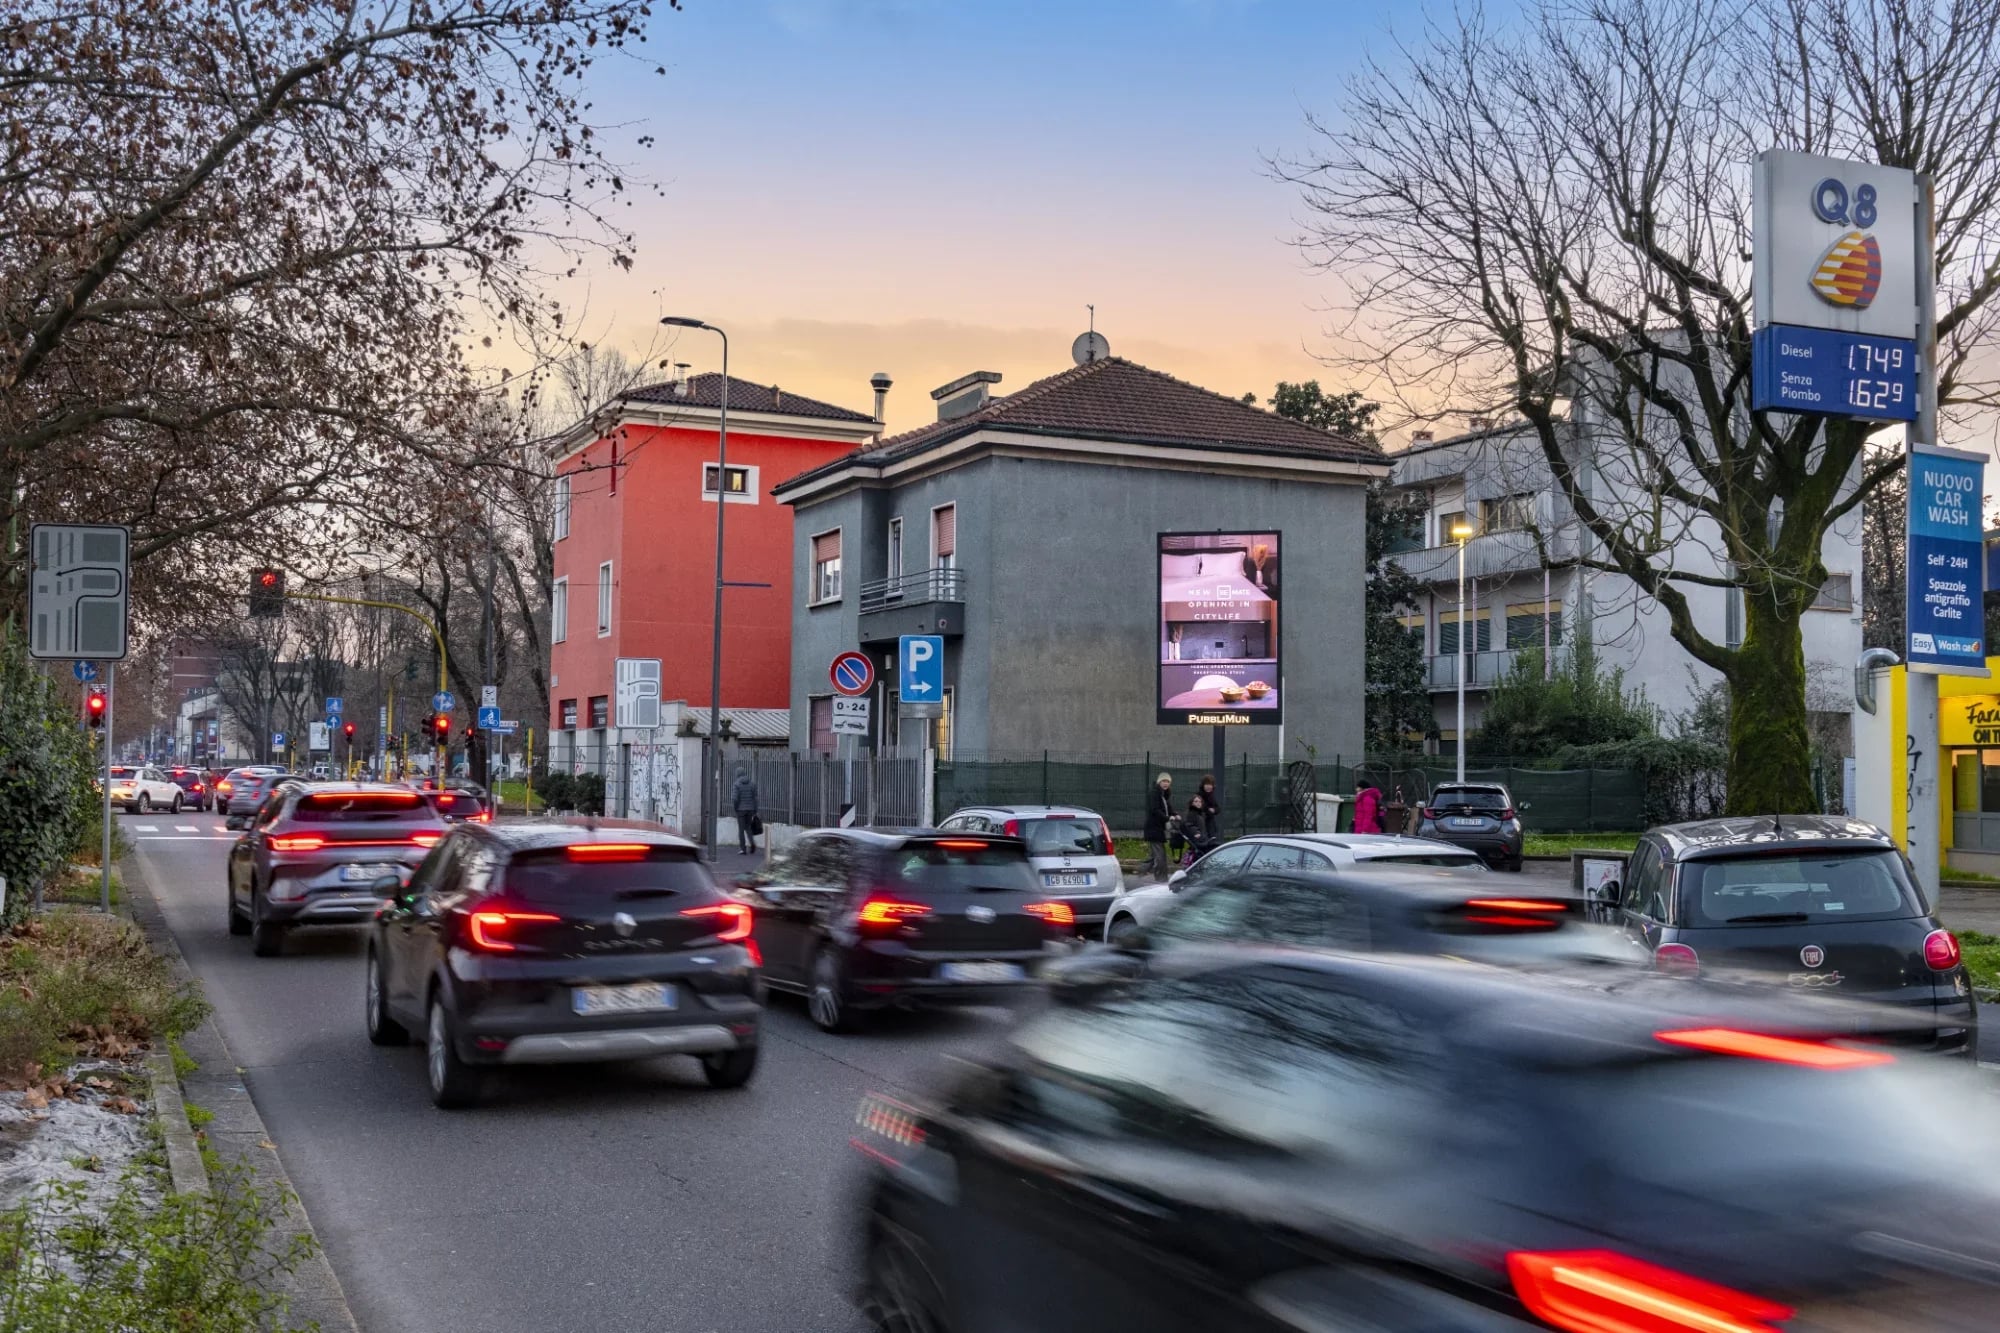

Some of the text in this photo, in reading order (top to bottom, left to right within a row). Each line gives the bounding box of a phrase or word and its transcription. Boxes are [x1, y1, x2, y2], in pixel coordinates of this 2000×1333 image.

[1812, 178, 1878, 229] Q8
[1781, 343, 1813, 358] Diesel
[1781, 371, 1813, 386] Senza
[1781, 386, 1821, 402] Piombo
[1924, 470, 1974, 492] NUOVO
[1935, 489, 1962, 508] CAR
[1928, 505, 1969, 526] WASH
[1927, 553, 1945, 566] Self
[1928, 577, 1967, 592] Spazzole
[1924, 592, 1971, 607] antigraffio
[1933, 606, 1963, 619] Carlite
[1913, 637, 1932, 651] Easy
[1938, 640, 1961, 651] Wash
[909, 640, 933, 672] P
[837, 702, 844, 710] 0
[852, 703, 866, 711] 24
[275, 734, 283, 744] P
[1973, 729, 1991, 743] ON
[1805, 951, 1819, 962] FIAT
